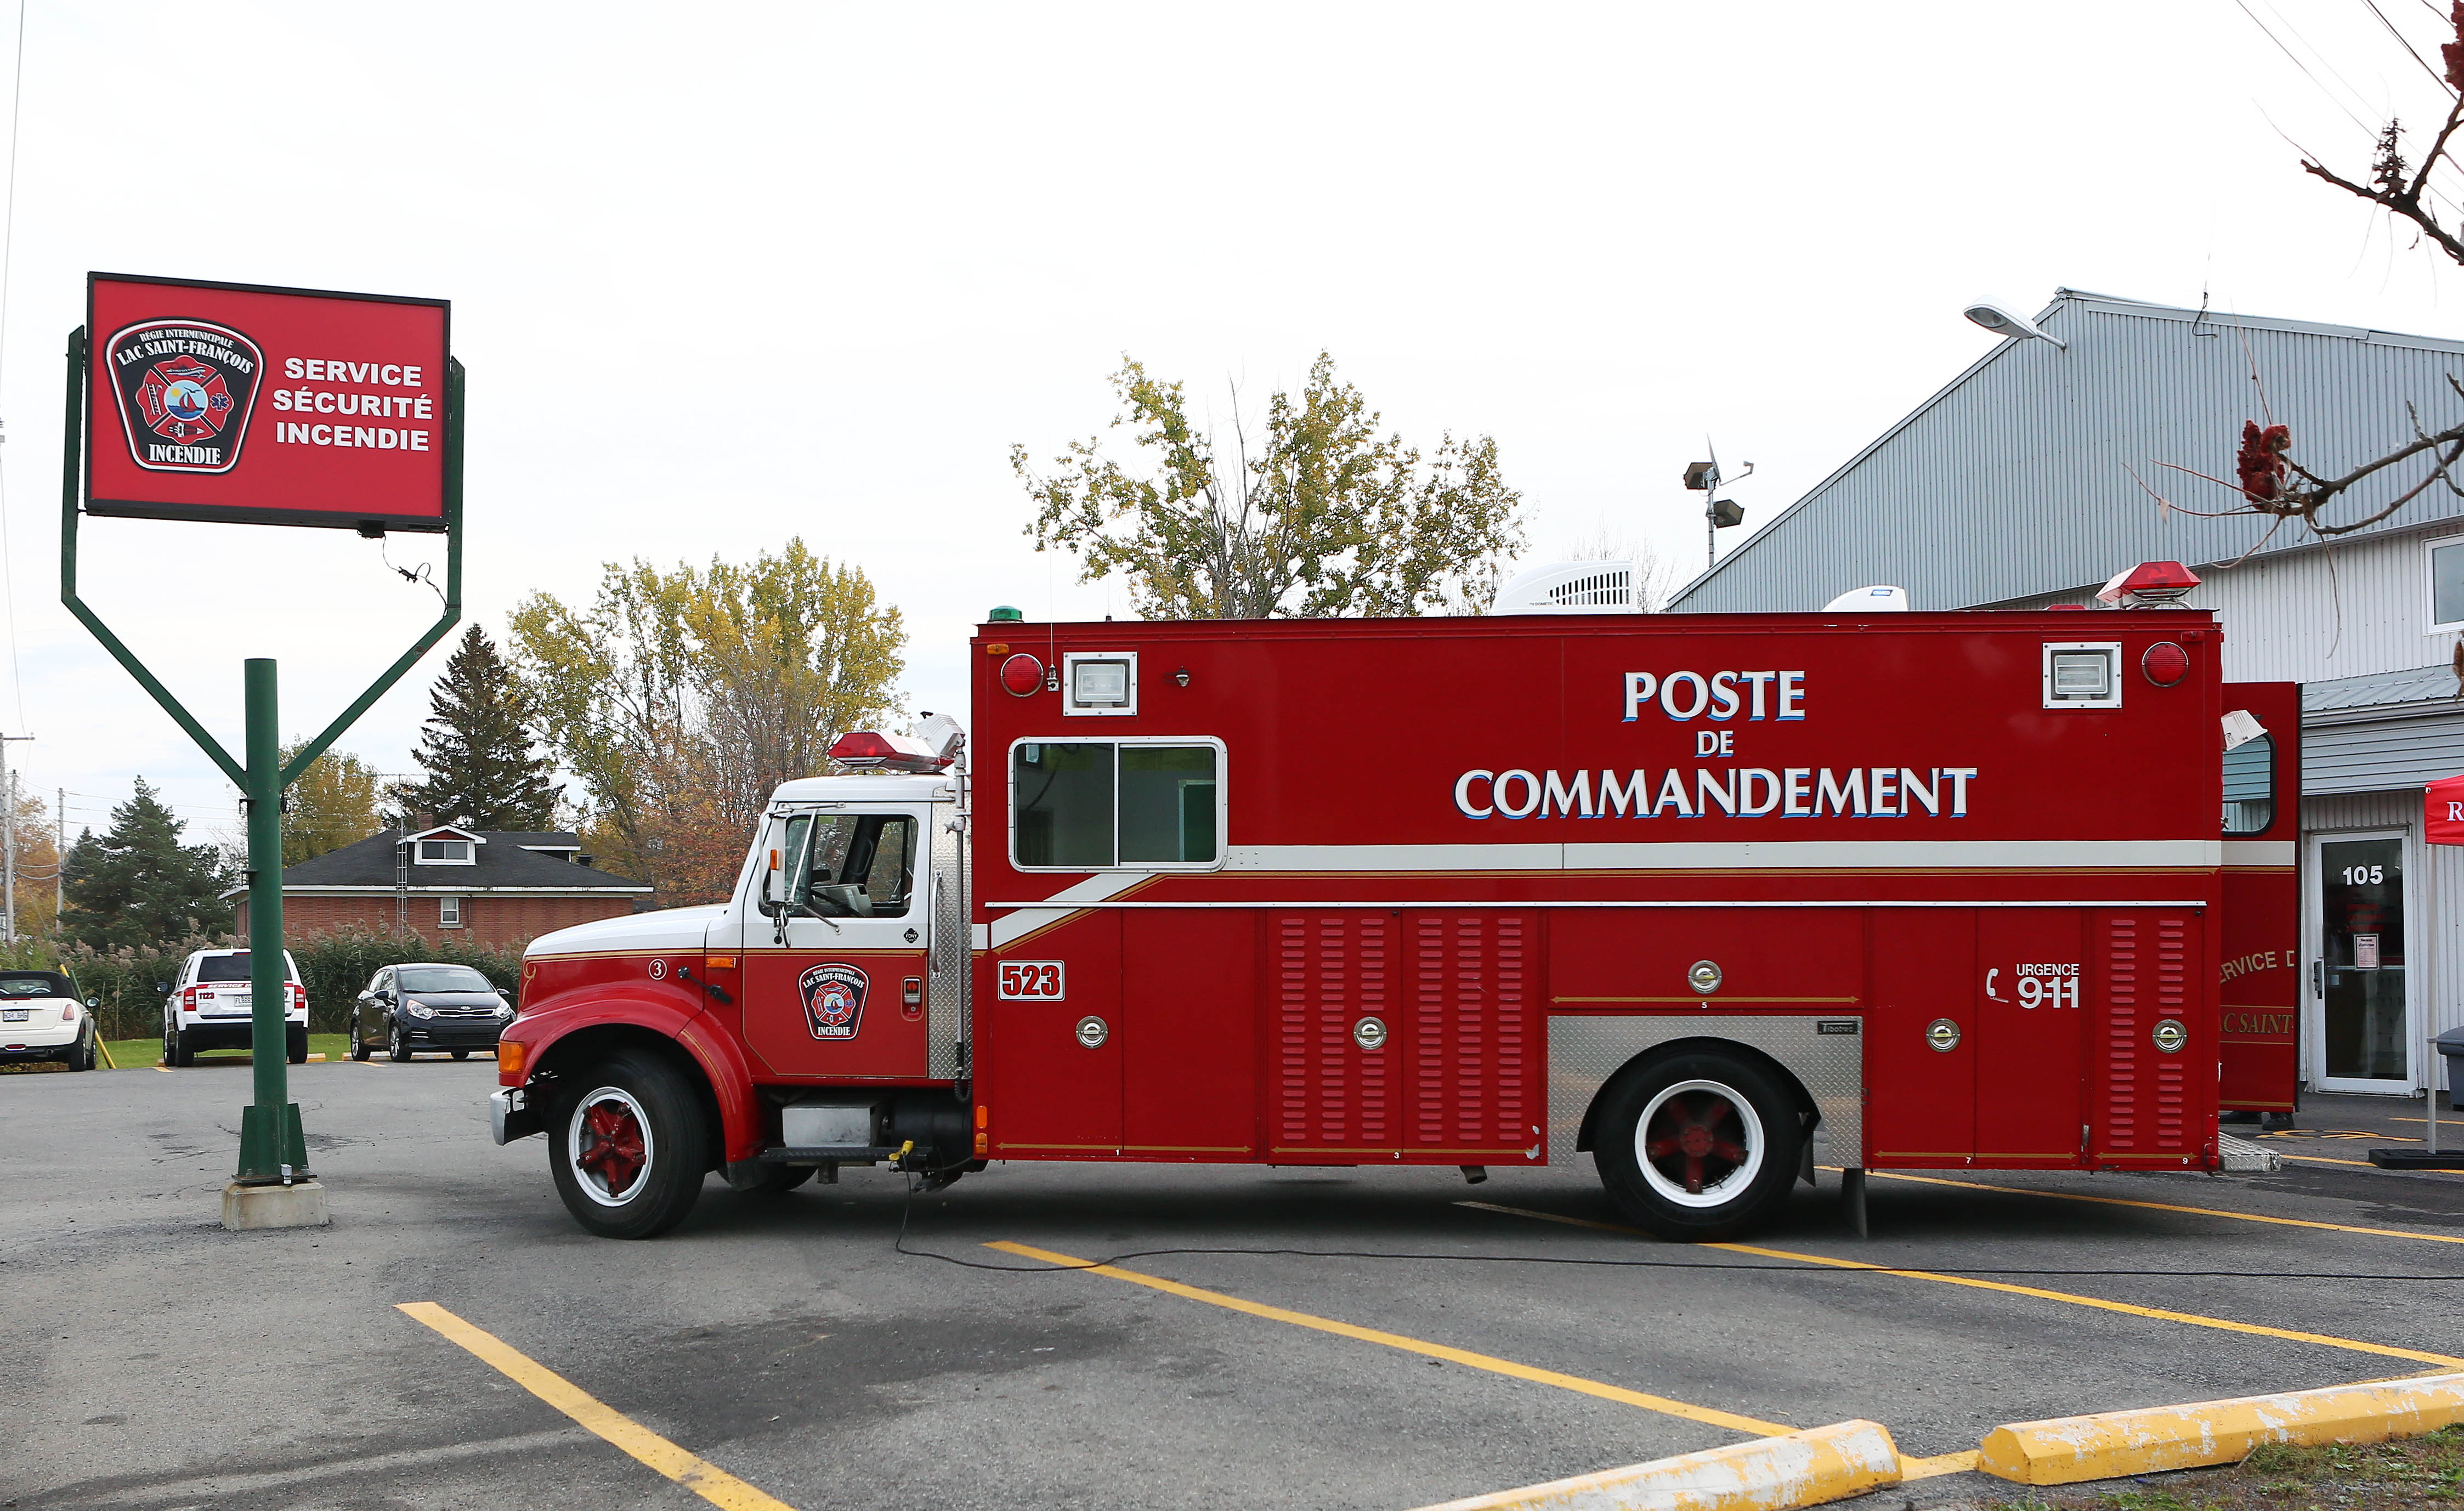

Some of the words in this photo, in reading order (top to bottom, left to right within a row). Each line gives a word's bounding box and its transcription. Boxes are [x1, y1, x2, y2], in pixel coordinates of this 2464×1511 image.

[139, 330, 165, 342] RÉGIE
[166, 329, 234, 348] INTERMUNICIPALE
[116, 344, 144, 366] LAC
[145, 339, 254, 373] SAINT-FRANÇOIS
[284, 358, 422, 387] SERVICE
[273, 386, 433, 420] SÉCURITÉ
[276, 422, 429, 451] INCENDIE
[149, 444, 220, 465] INCENDIE
[1622, 670, 1805, 722] POSTE
[1694, 730, 1734, 758] DE
[1454, 767, 1977, 819] COMMANDEMENT
[2343, 865, 2383, 885] 105
[654, 962, 662, 976] 3
[803, 977, 815, 988] LAC
[815, 973, 865, 988] SAINT-FRANÇOIS
[1002, 965, 1060, 996] 523
[2016, 964, 2080, 976] URGENCE
[818, 1026, 851, 1035] INCENDIE
